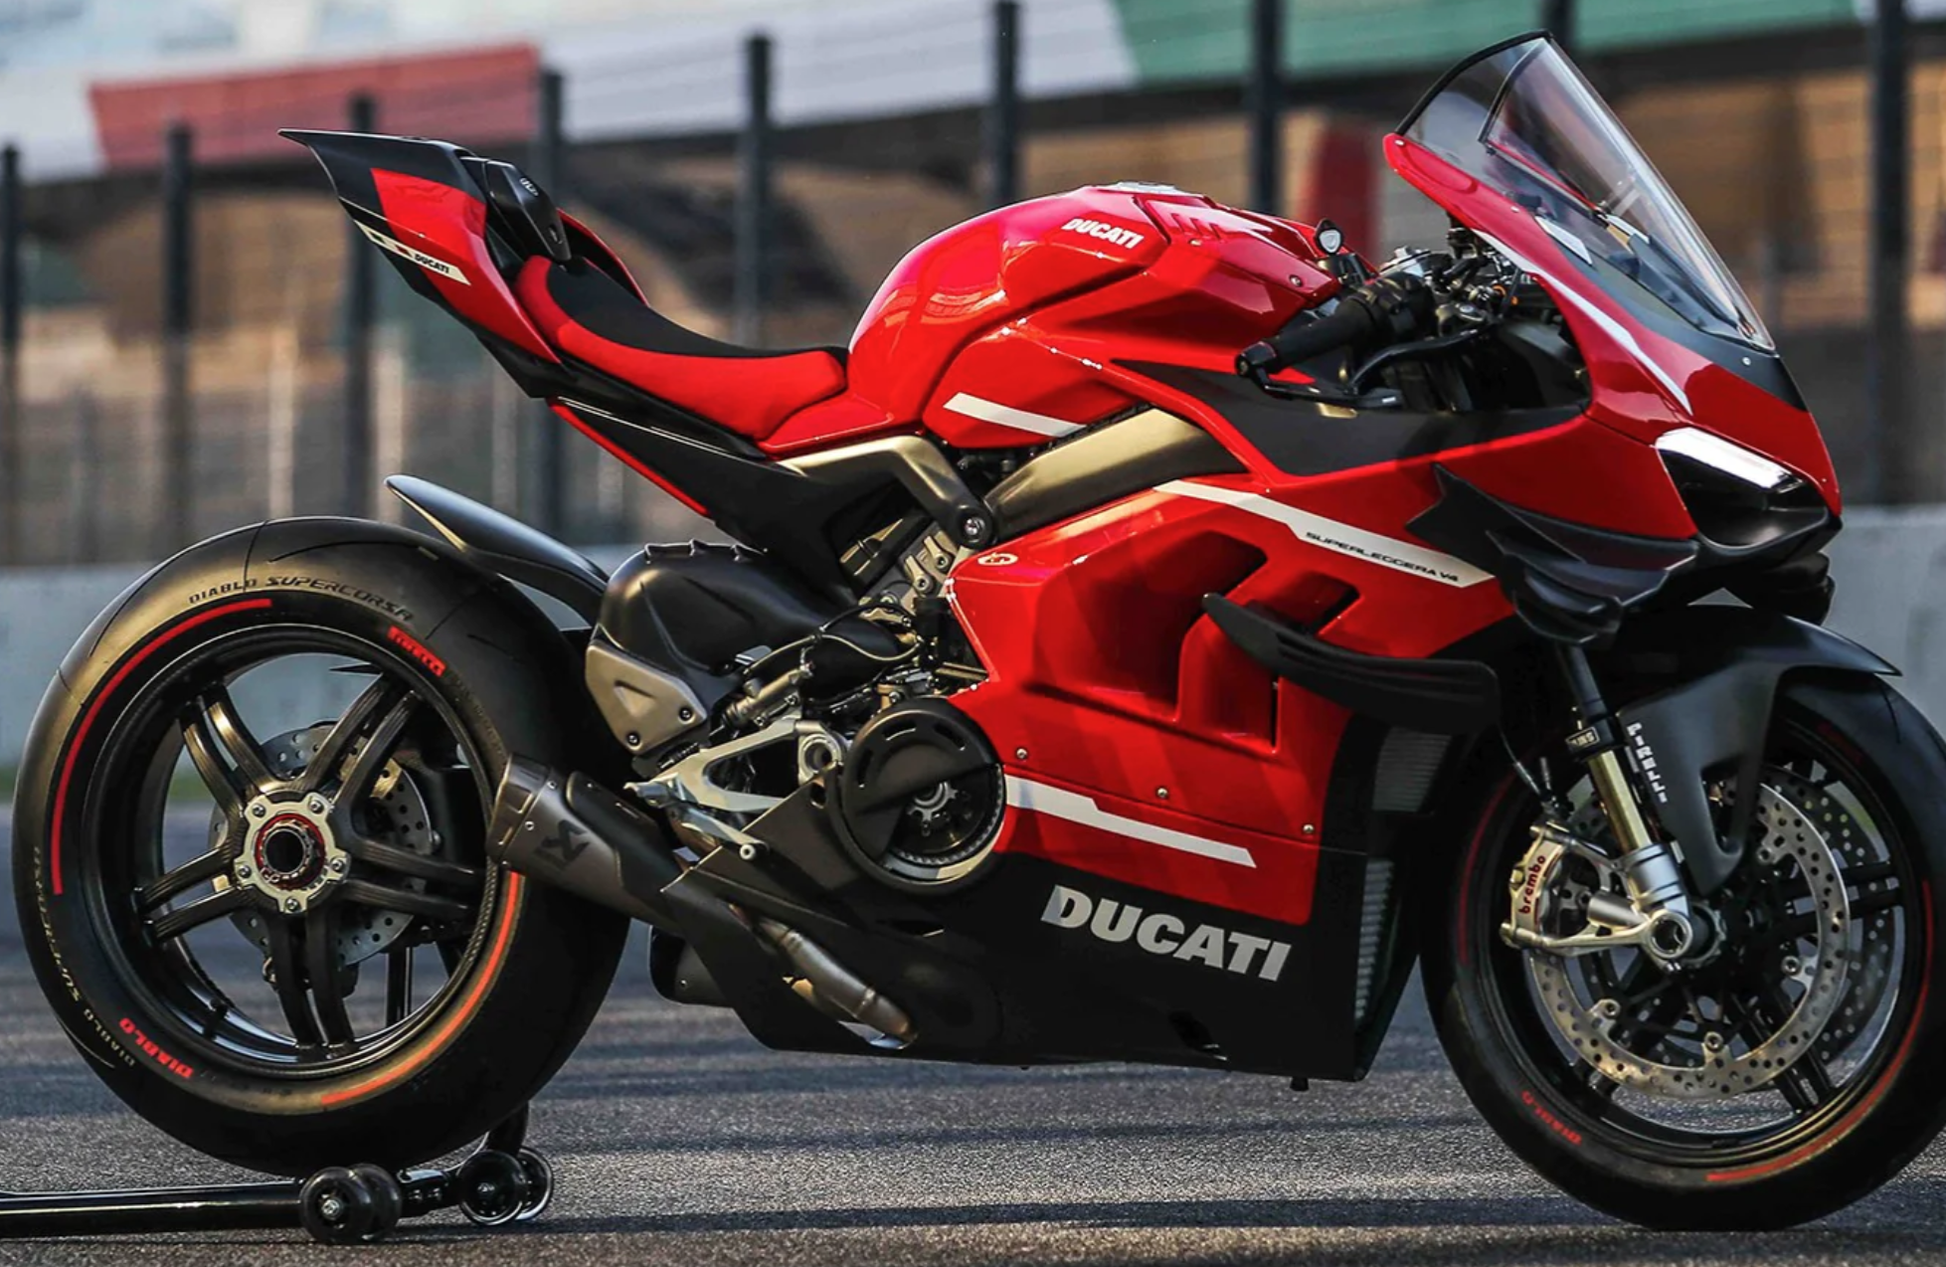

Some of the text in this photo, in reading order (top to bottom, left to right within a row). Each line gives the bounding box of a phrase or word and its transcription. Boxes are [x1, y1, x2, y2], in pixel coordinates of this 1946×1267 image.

[1060, 217, 1145, 250] DUCATI
[413, 252, 451, 274] DUCATI
[1305, 531, 1460, 583] SUPERLEGGERA V4
[188, 575, 415, 622] DIABLO SUPERCORSA
[1517, 855, 1546, 915] brembo
[1040, 884, 1292, 982] DUCATI
[83, 1007, 135, 1067] DIABLO
[118, 1017, 194, 1079] DIABLO
